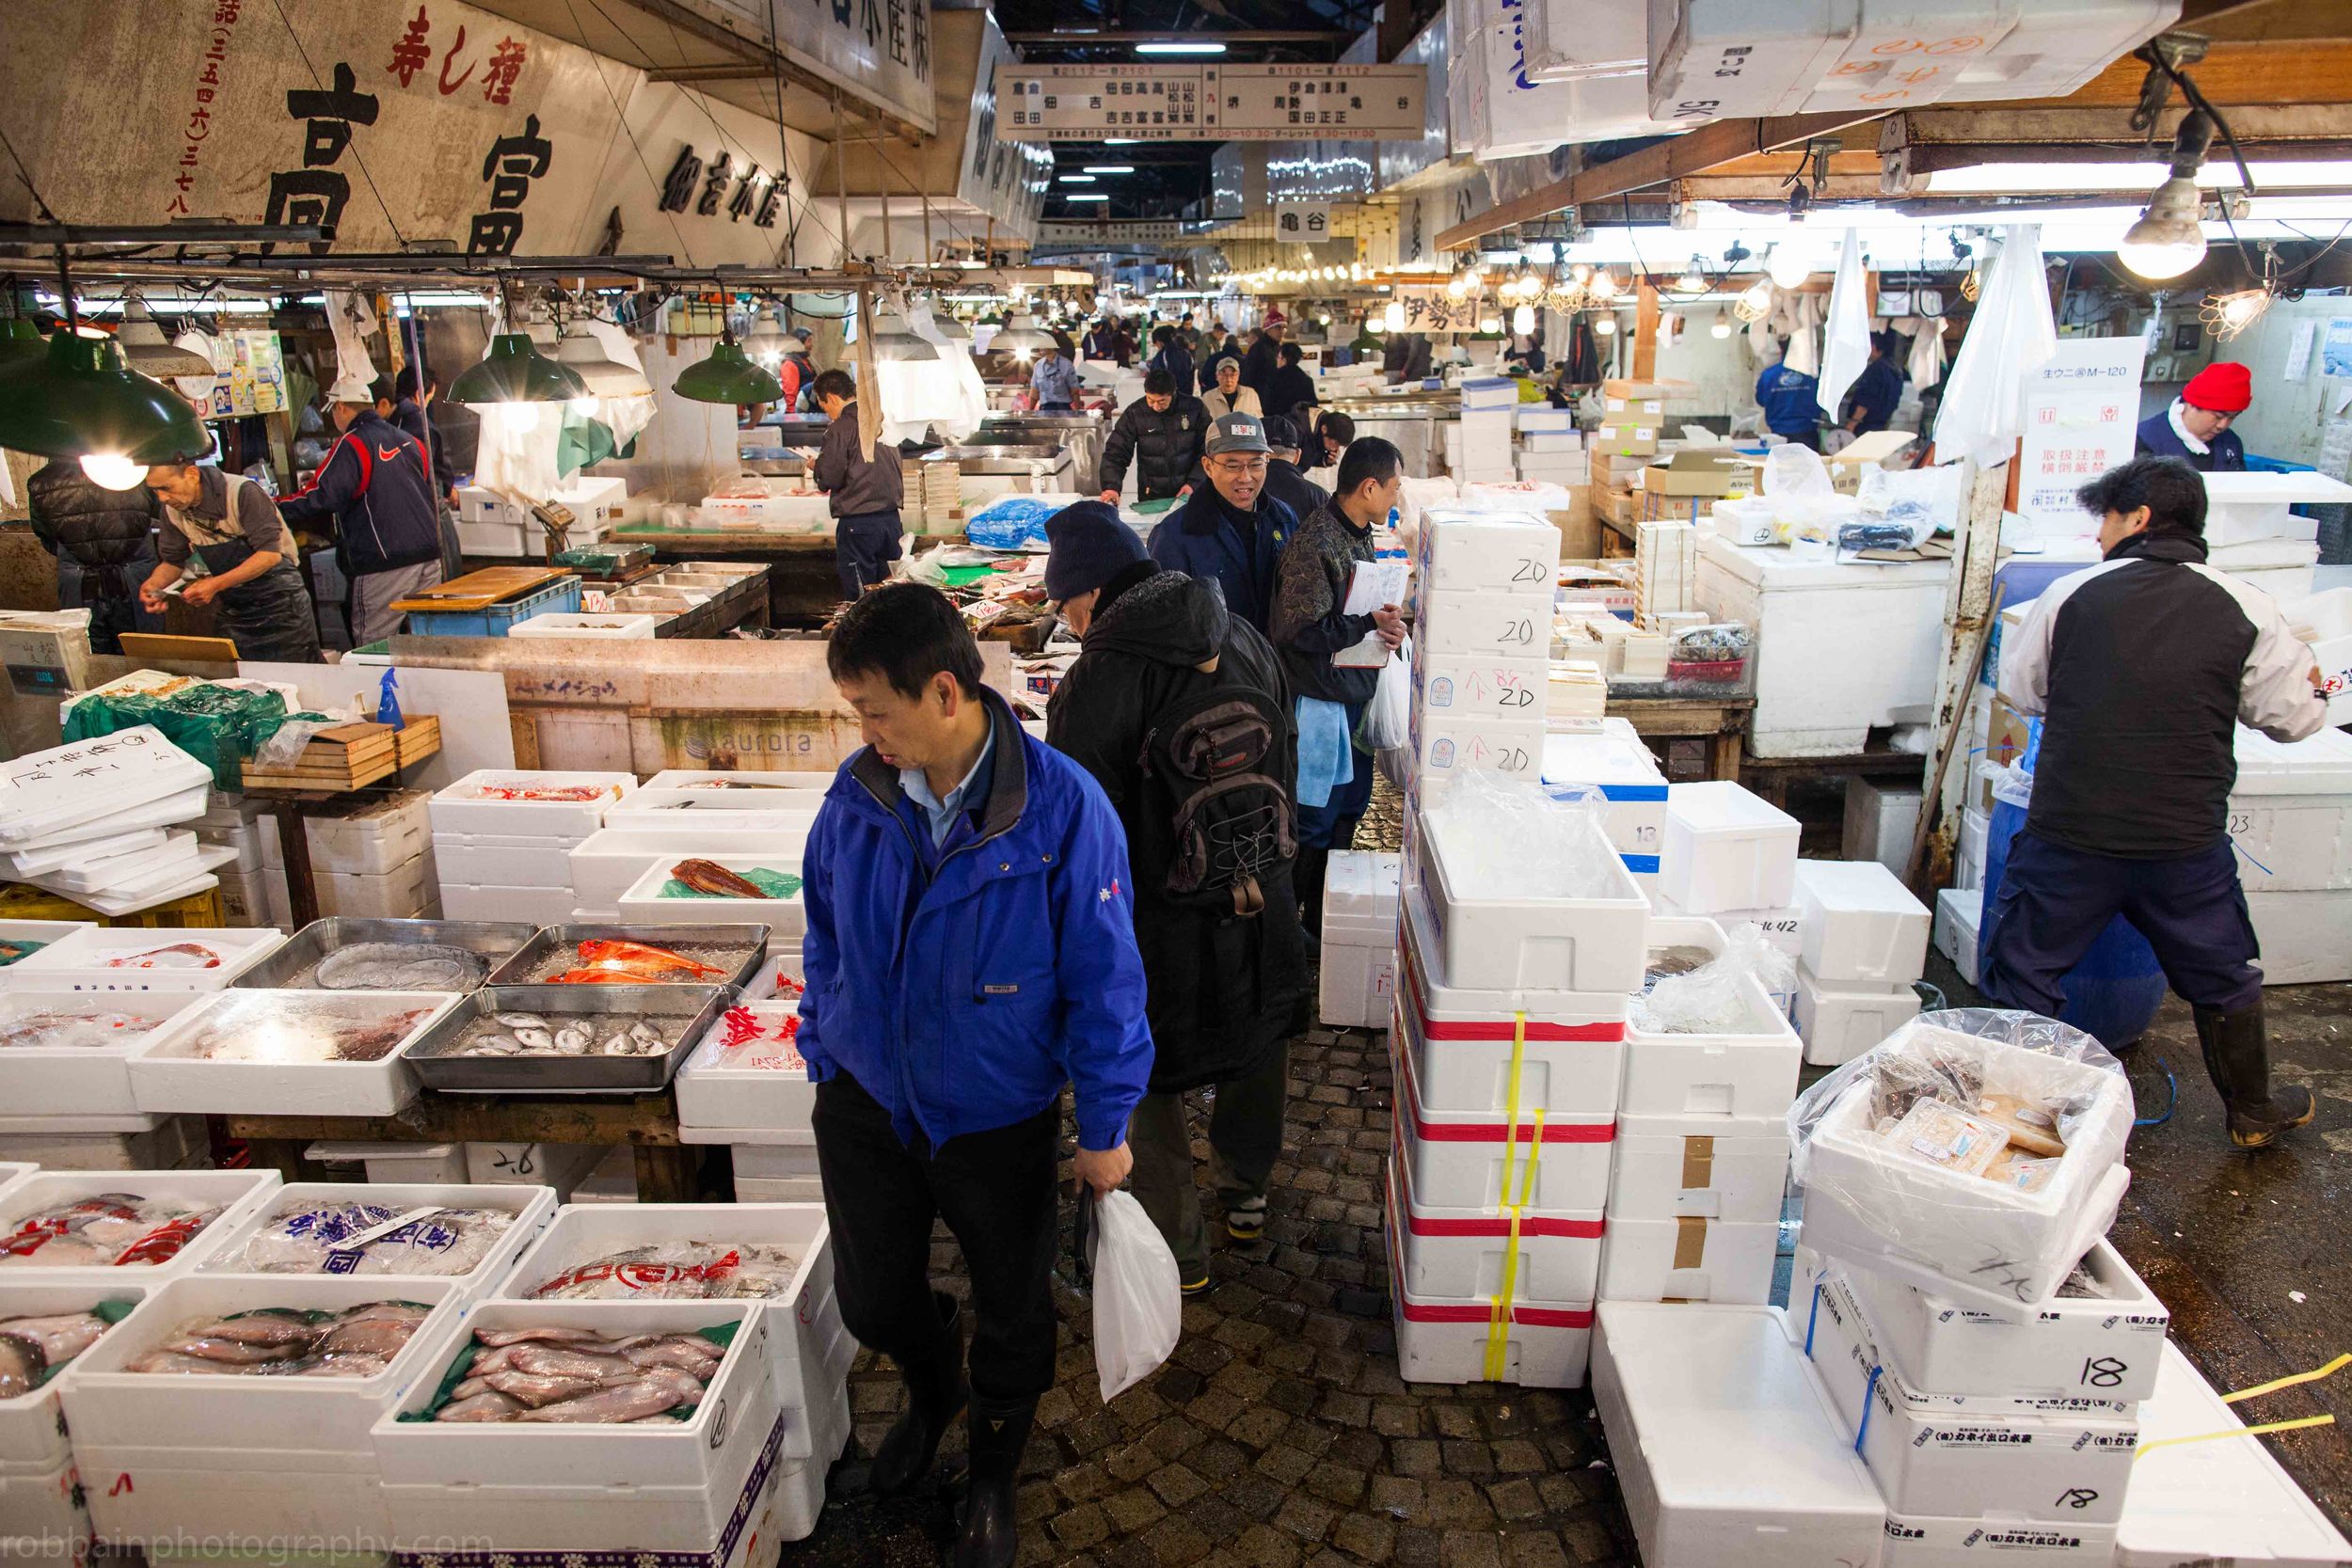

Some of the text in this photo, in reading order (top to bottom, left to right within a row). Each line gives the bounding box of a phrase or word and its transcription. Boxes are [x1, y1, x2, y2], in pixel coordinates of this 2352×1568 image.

[1281, 212, 1326, 231] 亀谷
[2042, 449, 2106, 461] 取扱注意
[1512, 559, 1548, 583] 20
[1498, 619, 1534, 645] 20
[723, 733, 812, 752] aurora
[2231, 815, 2249, 834] 23
[2081, 1356, 2128, 1387] 18
[2094, 1435, 2137, 1447] (有)カネ
